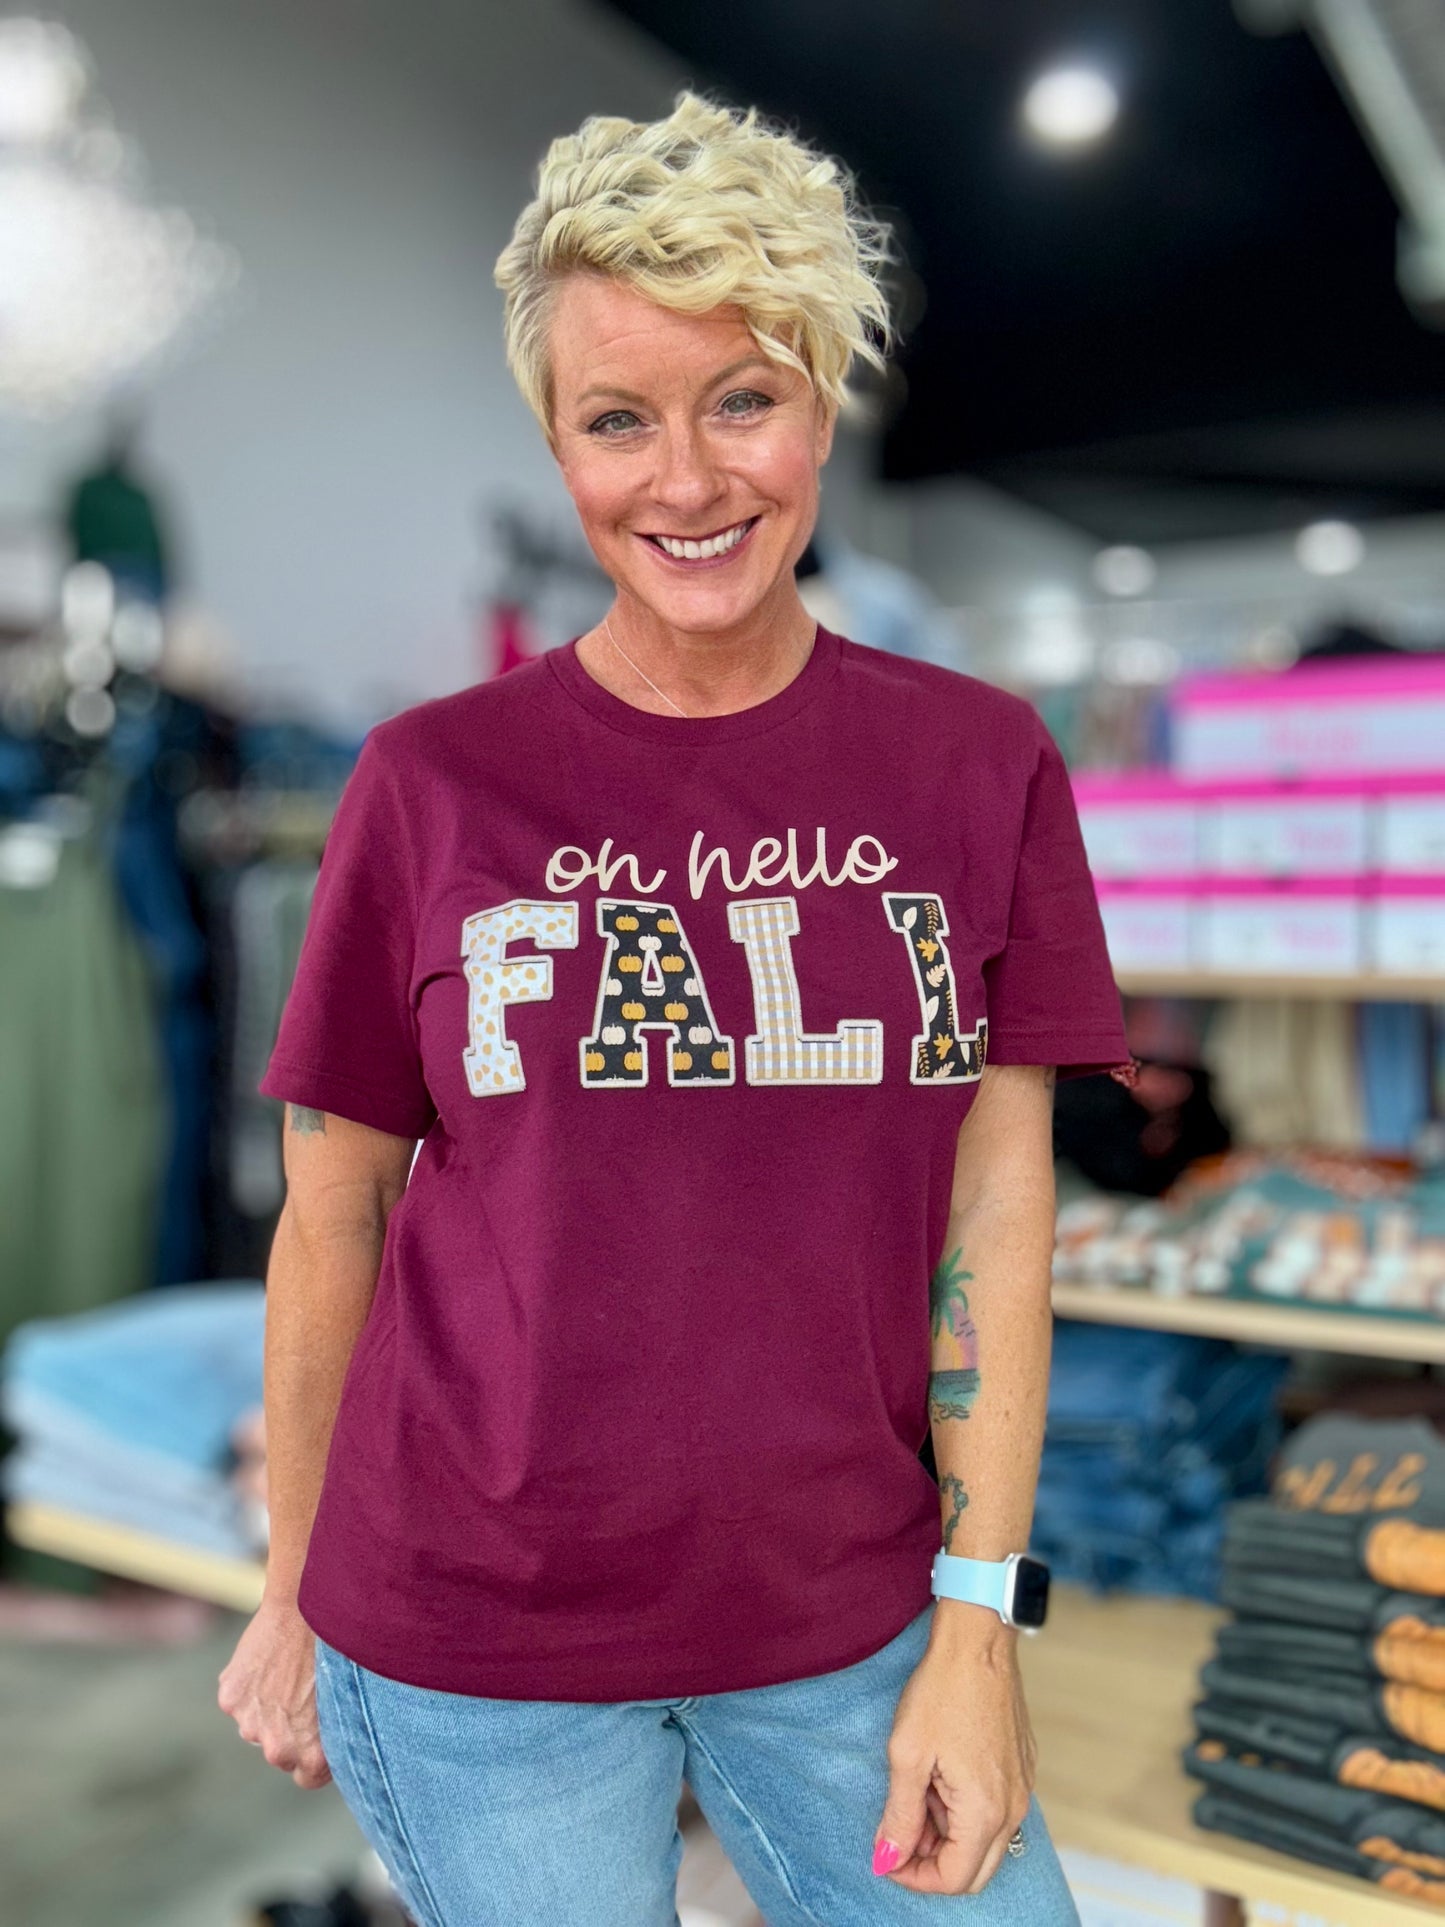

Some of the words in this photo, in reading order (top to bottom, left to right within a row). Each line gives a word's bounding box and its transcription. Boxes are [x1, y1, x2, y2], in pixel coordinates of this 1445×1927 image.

[546, 839, 666, 893] oh
[689, 827, 899, 899] hello
[462, 892, 988, 1097] FALL
